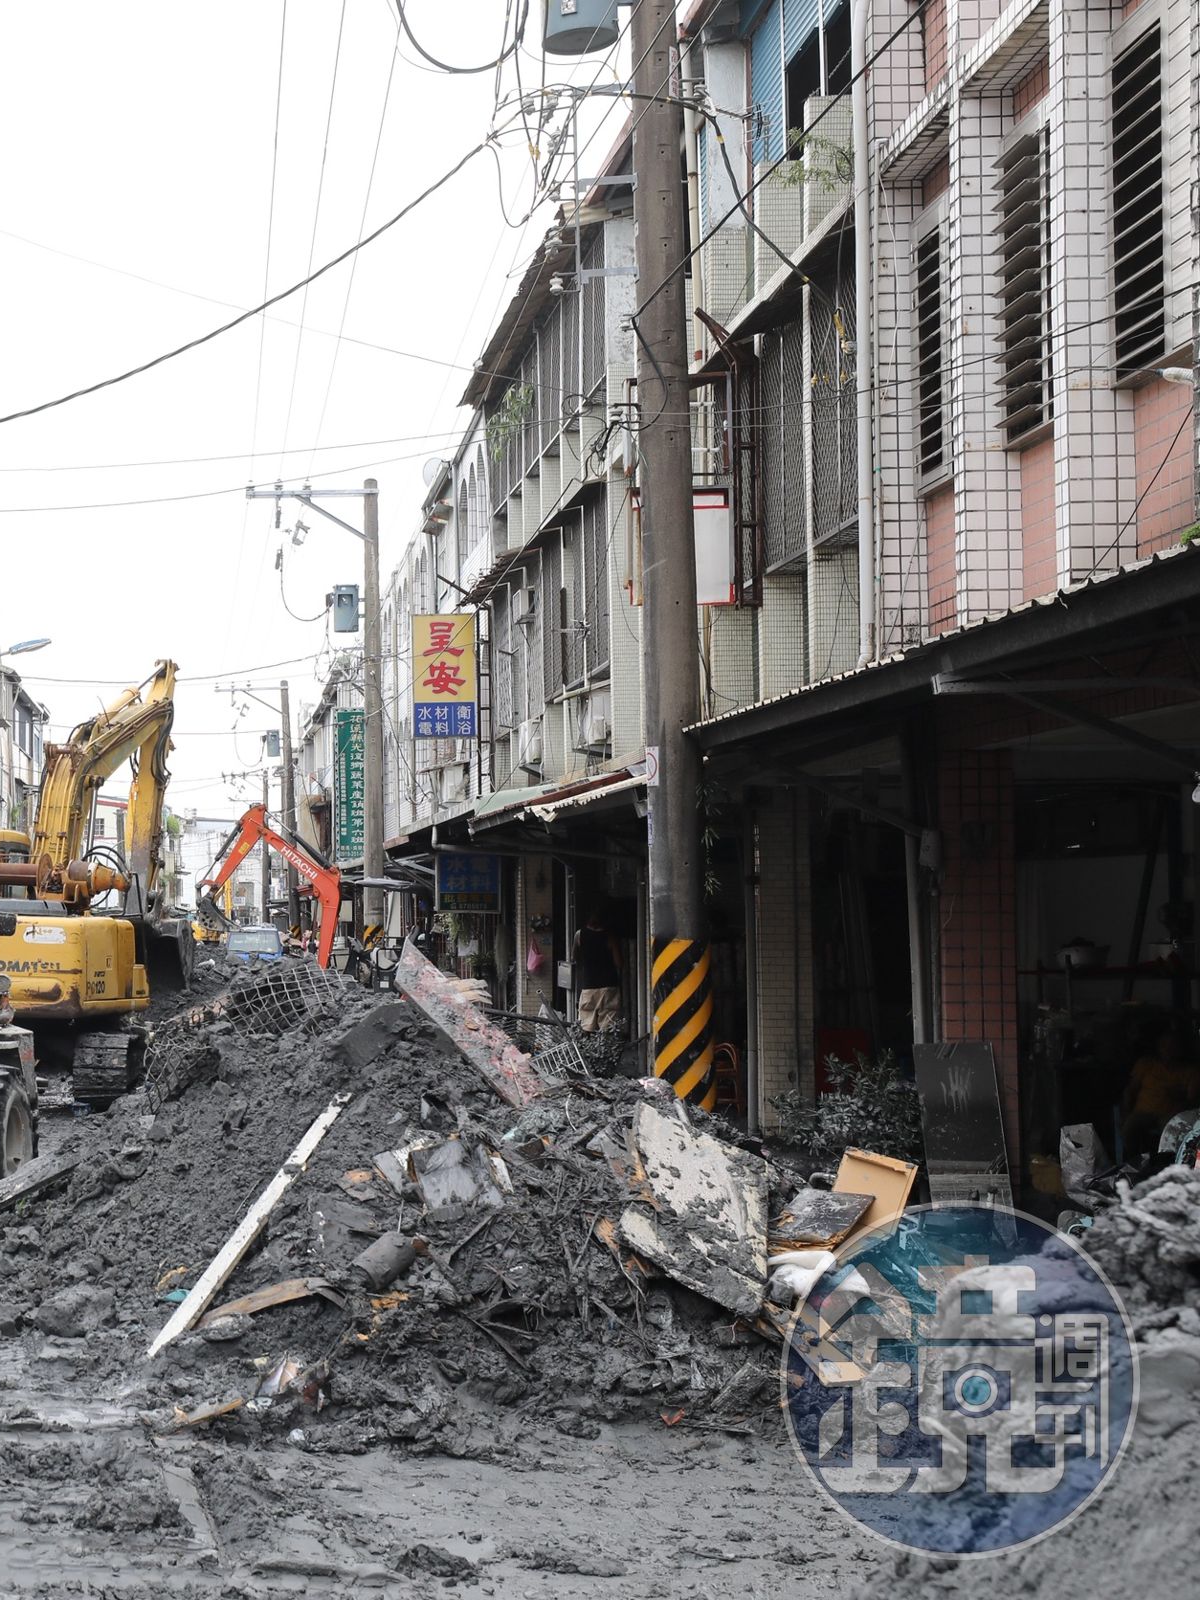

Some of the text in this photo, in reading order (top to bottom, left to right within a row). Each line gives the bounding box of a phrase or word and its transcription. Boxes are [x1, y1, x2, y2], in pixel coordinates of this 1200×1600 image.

[422, 621, 466, 696] 呈安
[457, 706, 472, 736] 衛浴
[280, 846, 318, 880] HITACHI
